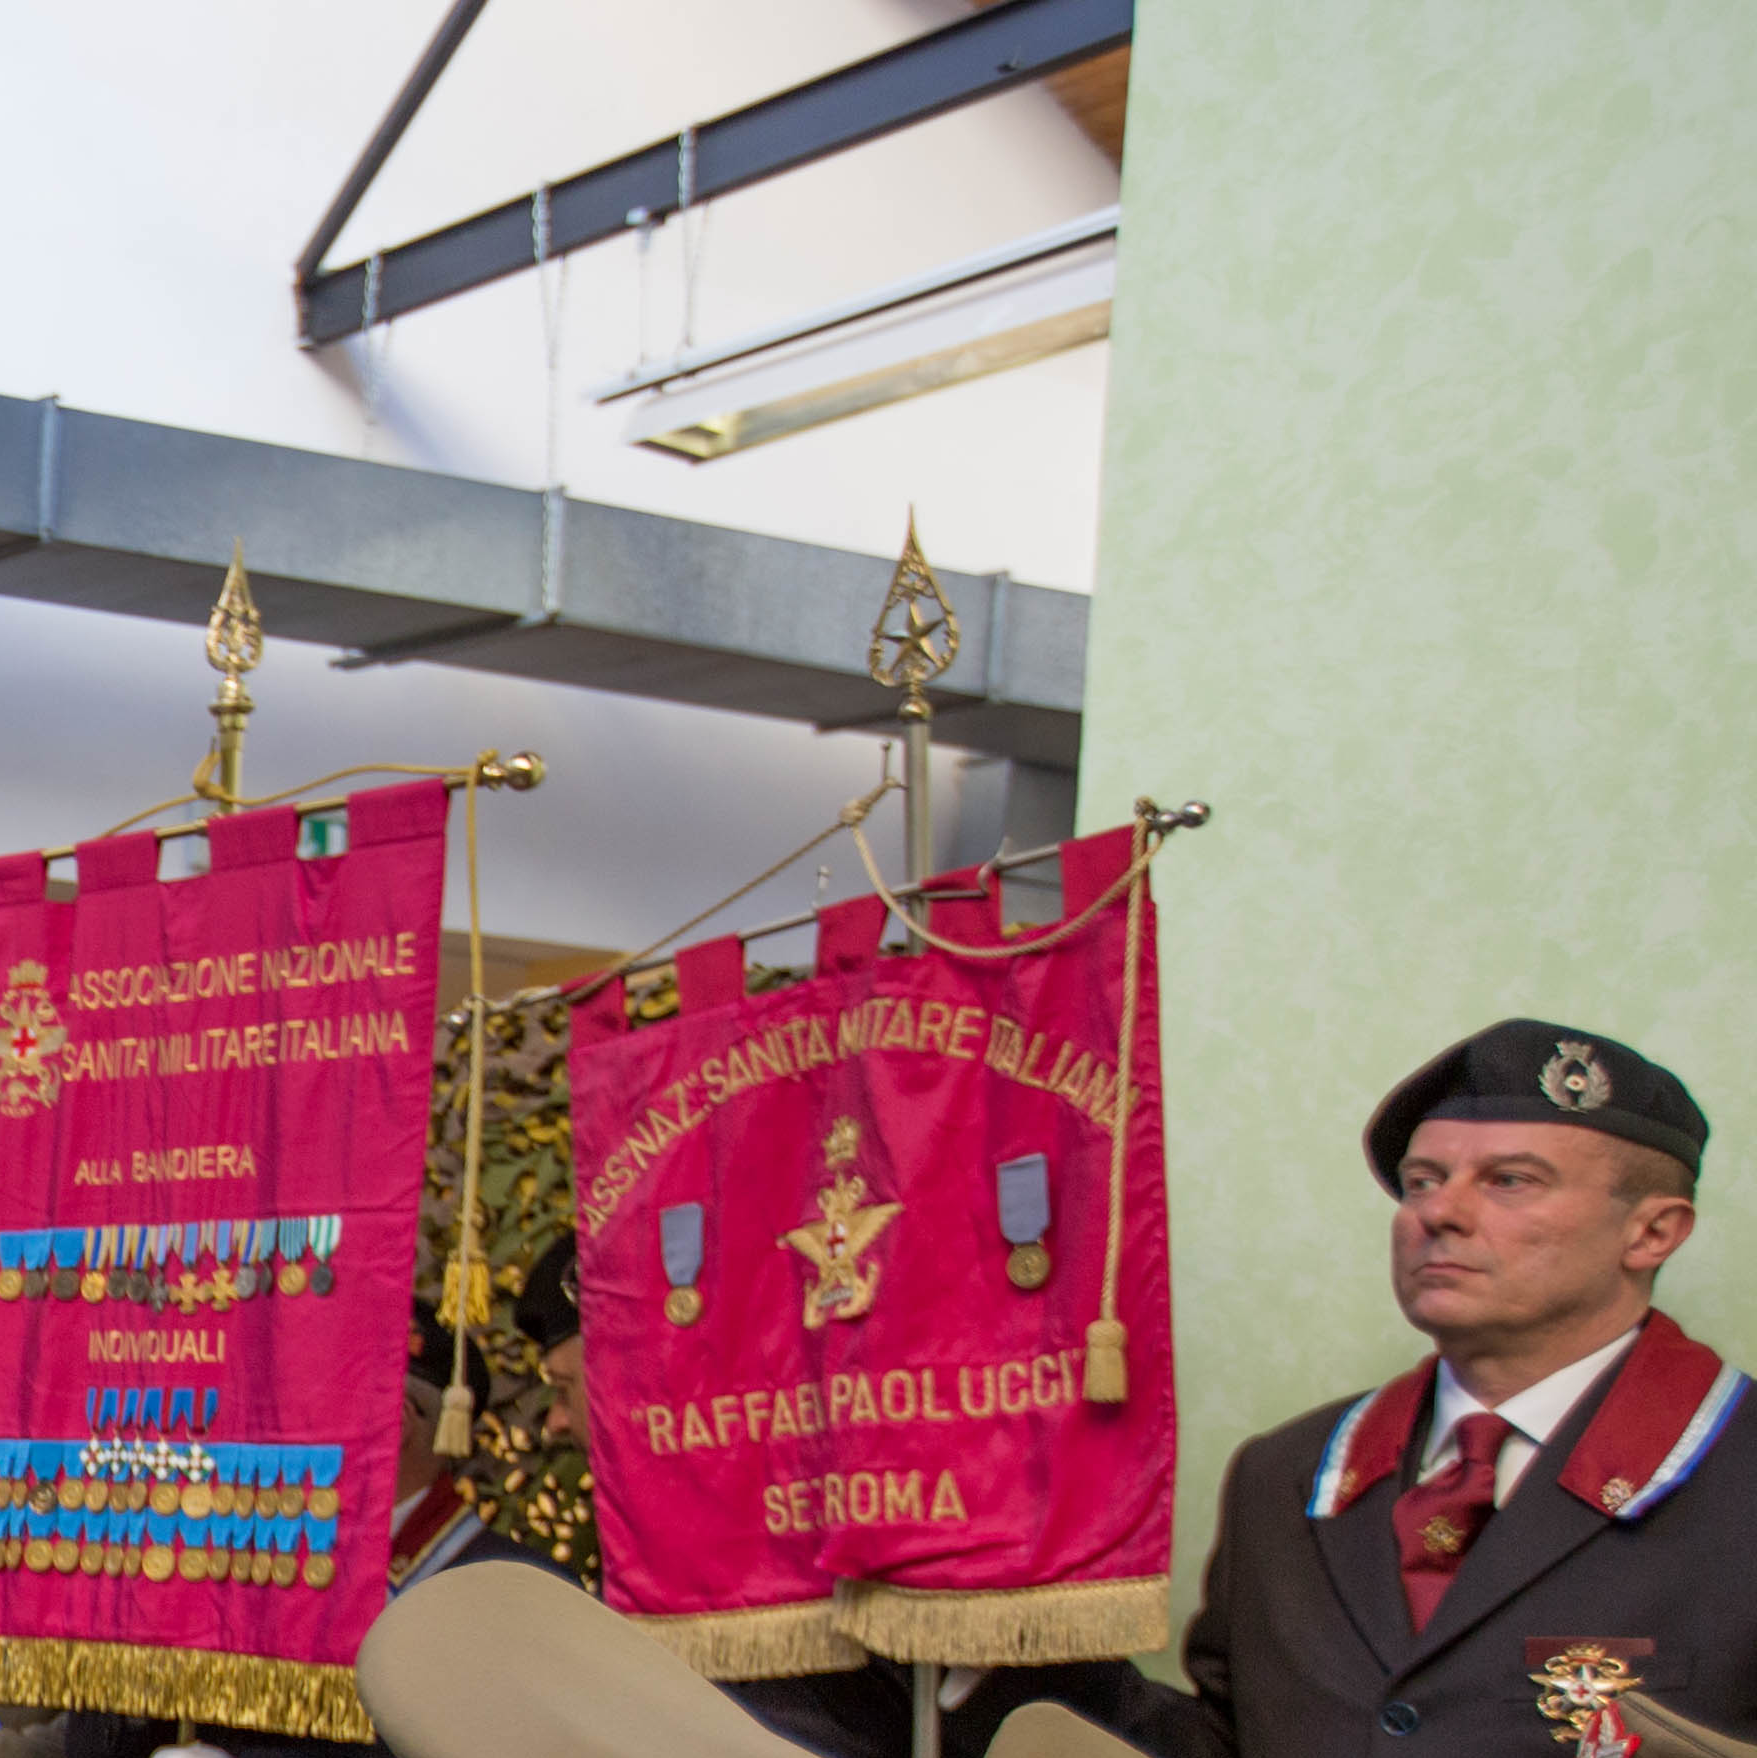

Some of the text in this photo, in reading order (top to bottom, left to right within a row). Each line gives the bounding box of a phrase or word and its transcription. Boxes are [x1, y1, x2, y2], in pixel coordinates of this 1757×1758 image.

[68, 931, 416, 1010] ASSOCIAZIONE NAZIONALE
[157, 1022, 277, 1076] MILITARE
[280, 1010, 410, 1062] ITALIANA
[74, 1144, 256, 1185] ALLA BANDIERA
[823, 1468, 968, 1526] ROMA
